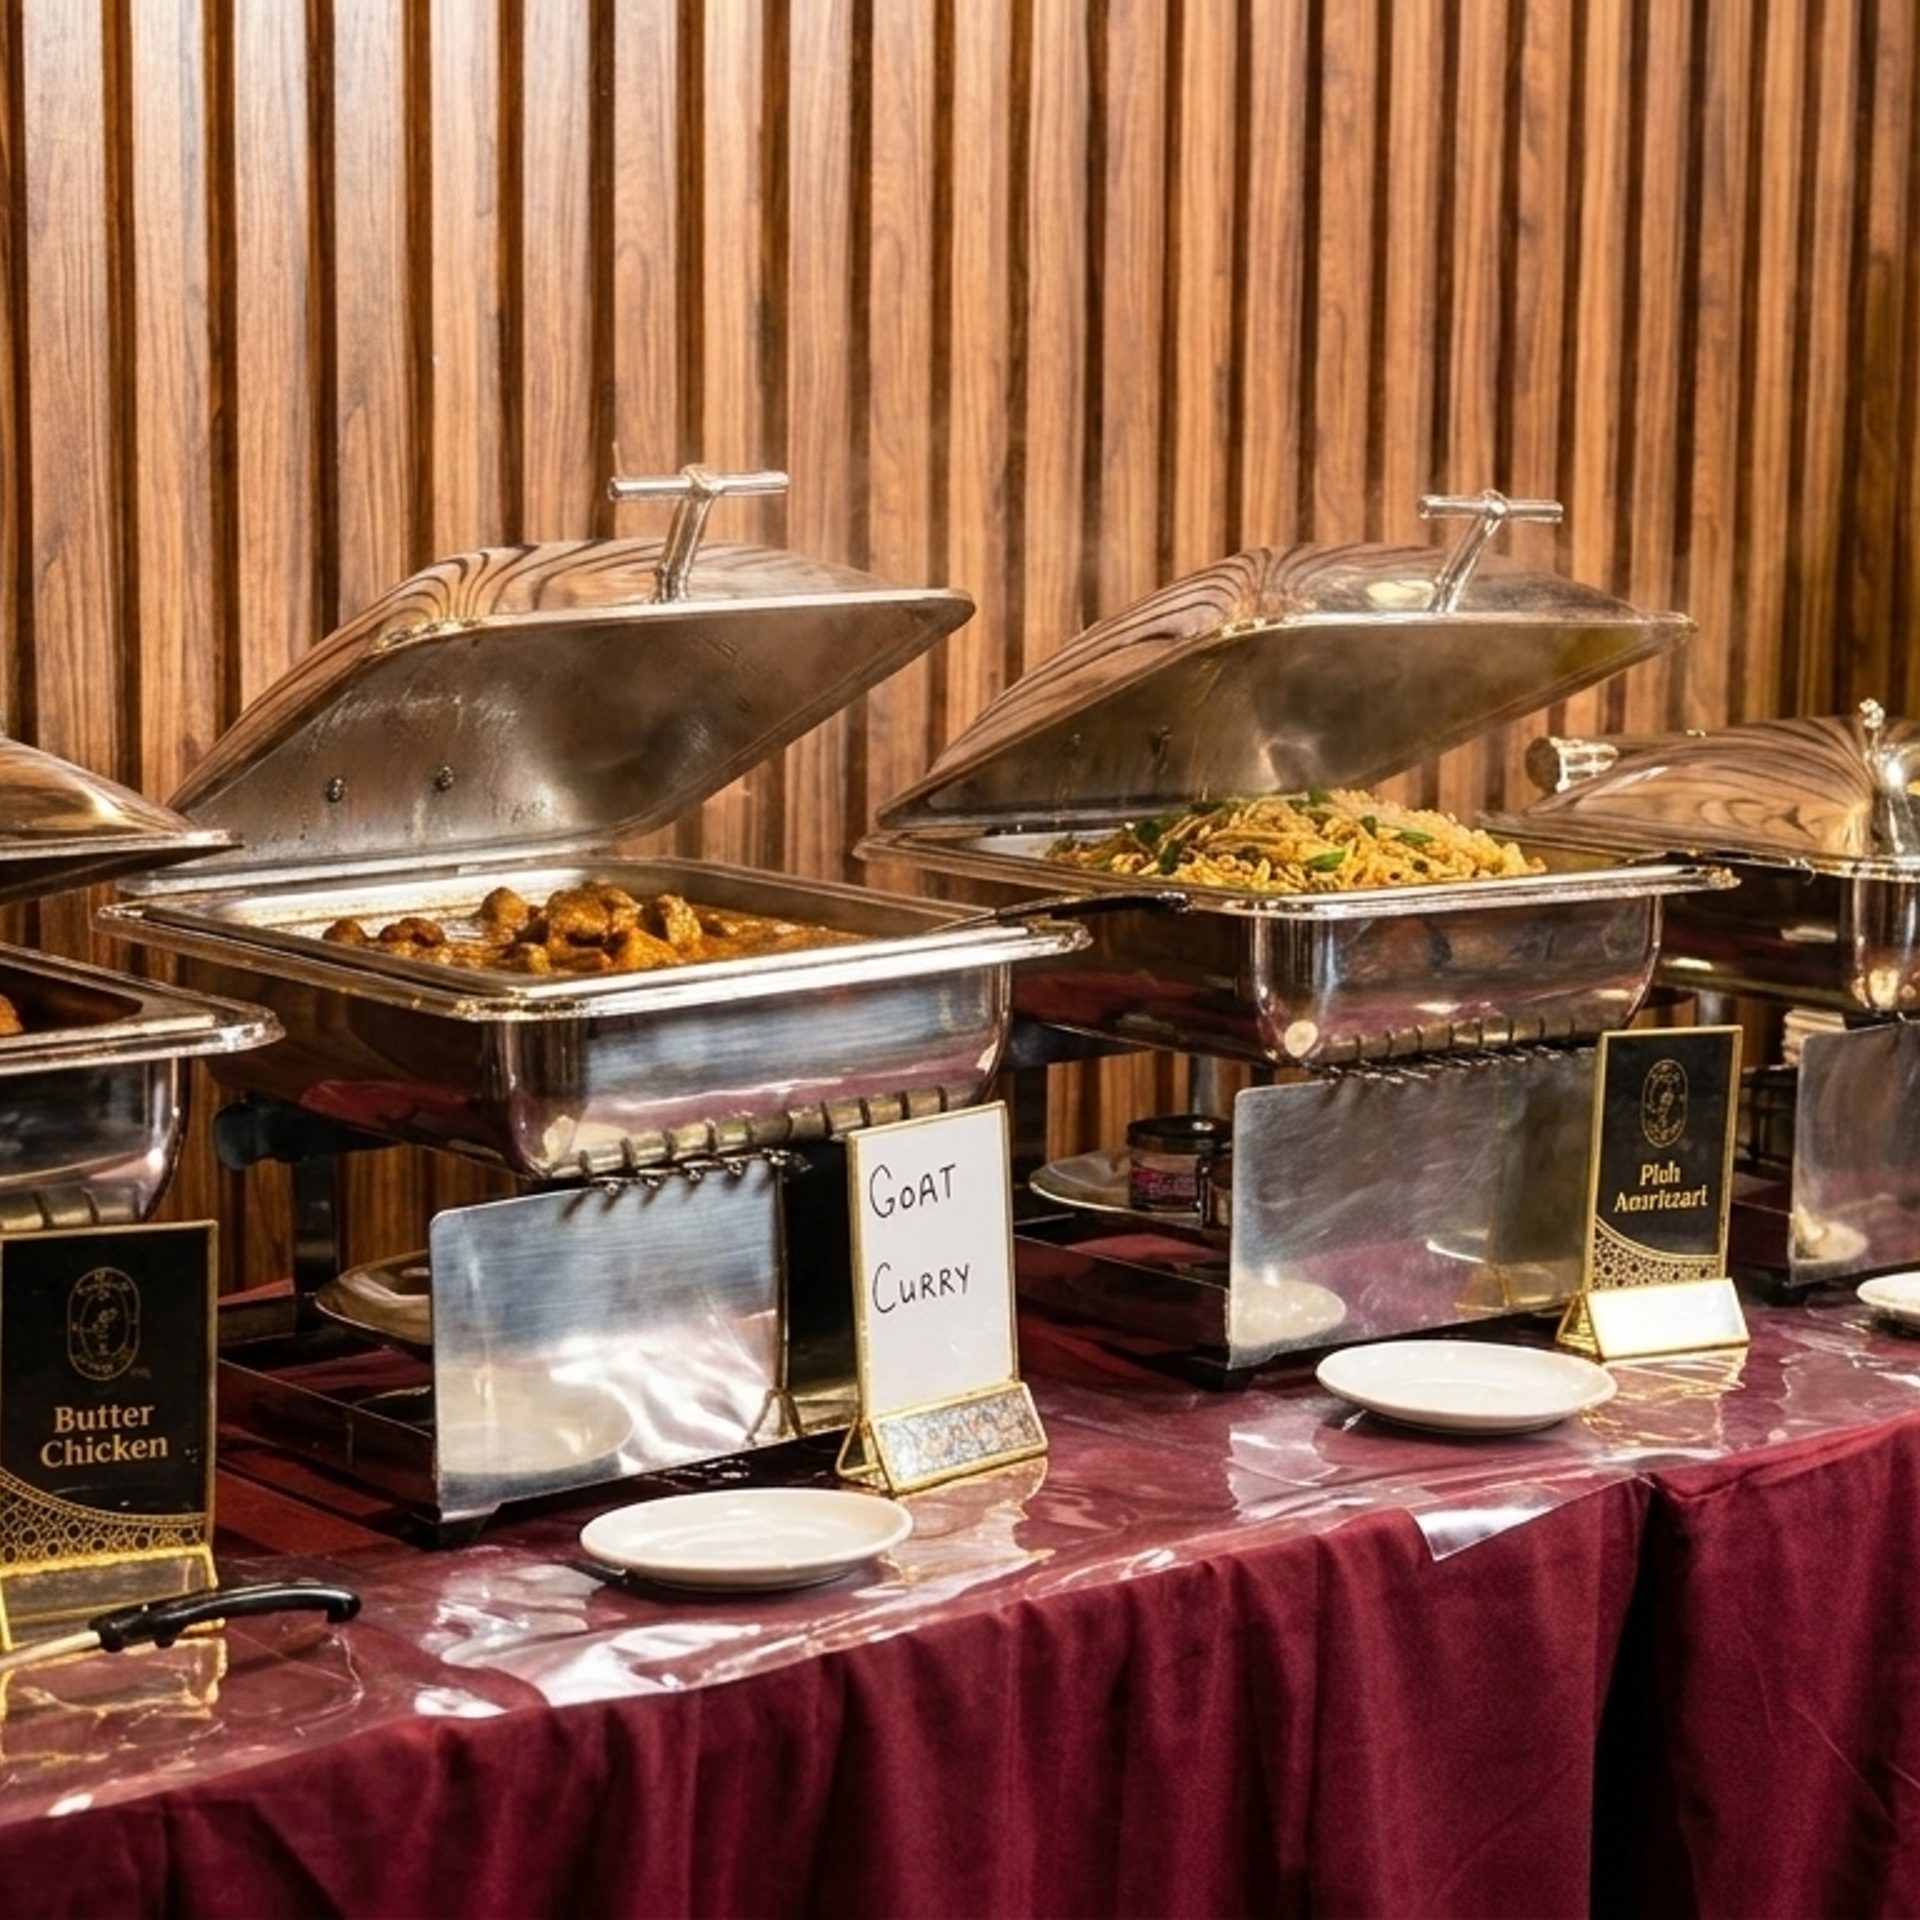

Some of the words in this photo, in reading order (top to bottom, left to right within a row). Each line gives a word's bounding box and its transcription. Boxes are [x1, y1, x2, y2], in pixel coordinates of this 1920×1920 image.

[869, 1163, 957, 1219] GOAT
[872, 1262, 971, 1314] CURRY
[54, 1404, 154, 1433] Butter
[40, 1434, 168, 1468] Chicken
